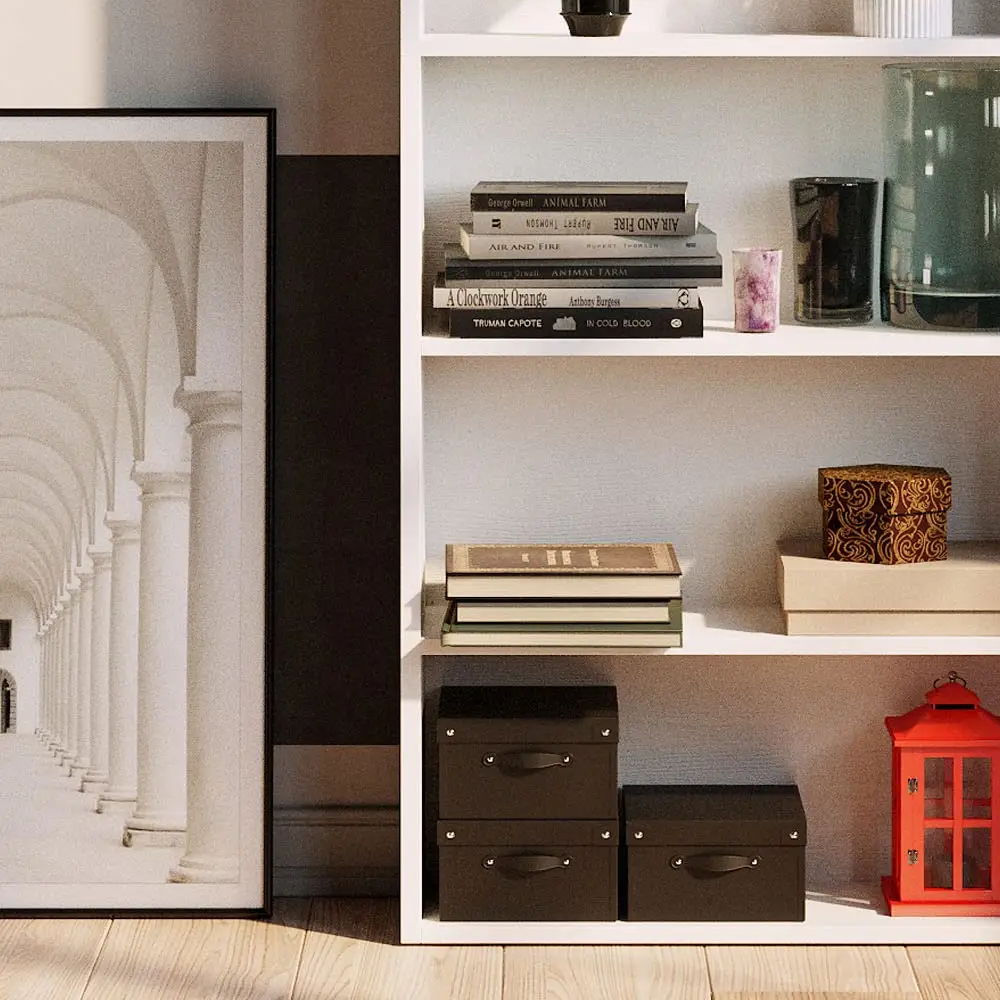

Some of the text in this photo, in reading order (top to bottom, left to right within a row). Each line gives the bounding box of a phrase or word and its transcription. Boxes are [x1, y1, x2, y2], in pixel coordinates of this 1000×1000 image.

[488, 198, 510, 209] George
[543, 198, 580, 208] ANIMAL
[582, 198, 607, 208] FARM
[526, 219, 591, 230] RUPERT THOMSON
[614, 218, 679, 232] AIR AND FIRE
[489, 243, 508, 251] AIR
[538, 242, 561, 250] FIRE
[551, 268, 594, 277] ANIMAL
[597, 268, 628, 277] FARM
[446, 290, 455, 306] A
[456, 288, 508, 306] Clockwork
[511, 289, 548, 309] Orange
[473, 318, 542, 328] TRUMAN CAPOTE
[597, 319, 619, 328] COLD
[623, 319, 652, 328] BLOOD
